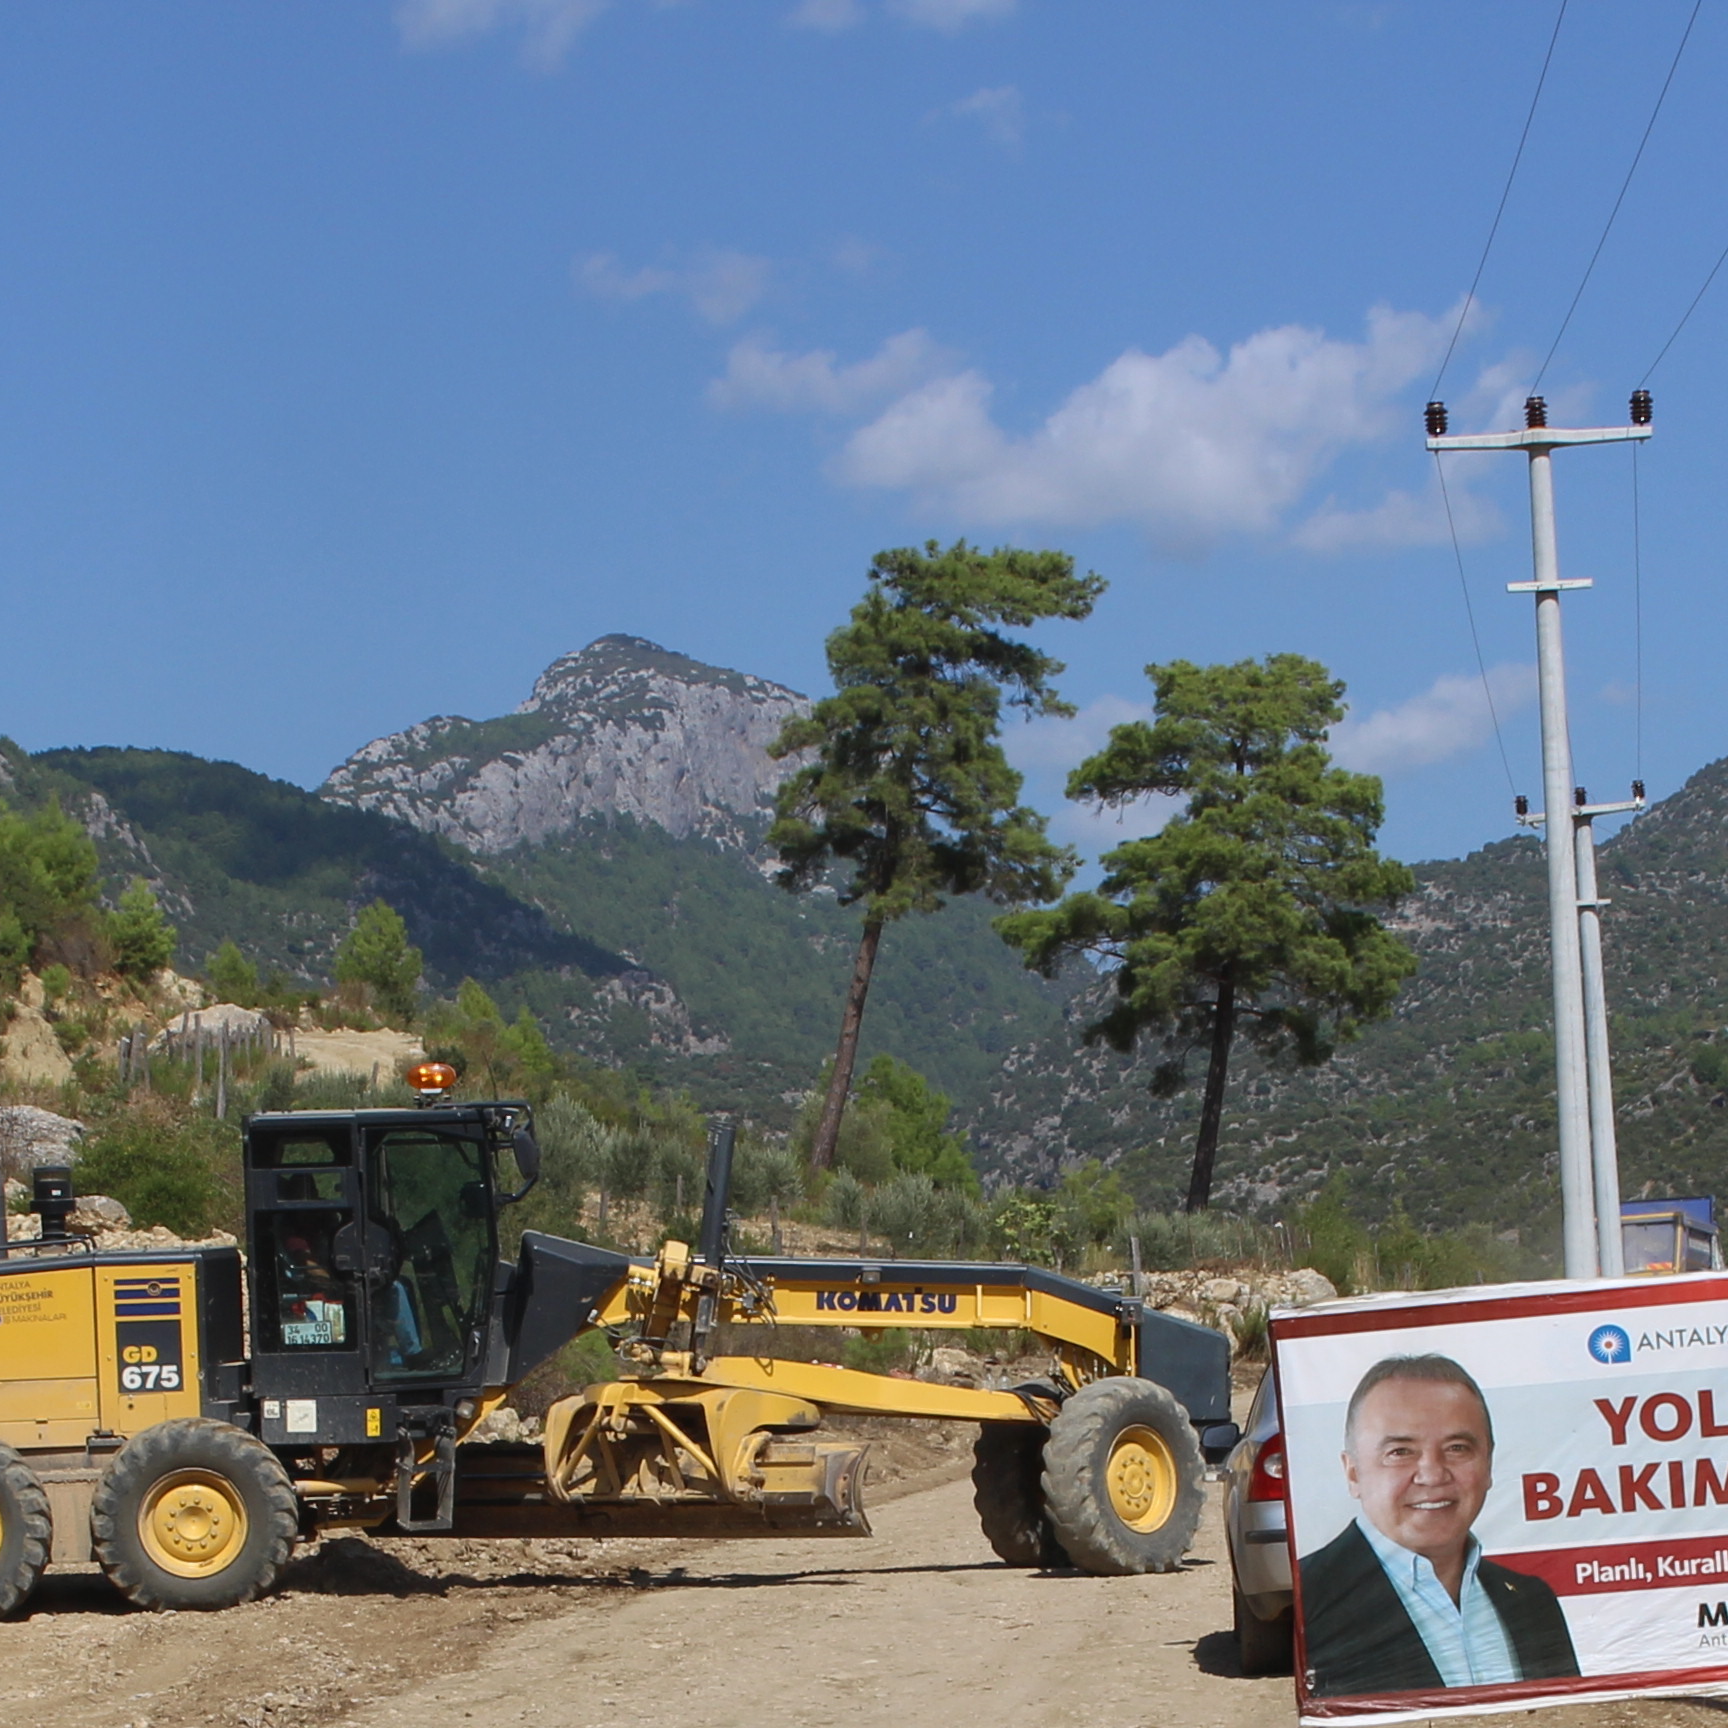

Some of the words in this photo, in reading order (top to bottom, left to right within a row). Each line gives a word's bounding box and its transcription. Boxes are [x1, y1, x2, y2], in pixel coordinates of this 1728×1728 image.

[816, 1290, 957, 1314] KOMATSU
[122, 1345, 158, 1364] GD
[121, 1365, 180, 1390] 675
[1575, 1557, 1653, 1585] Planlı,
